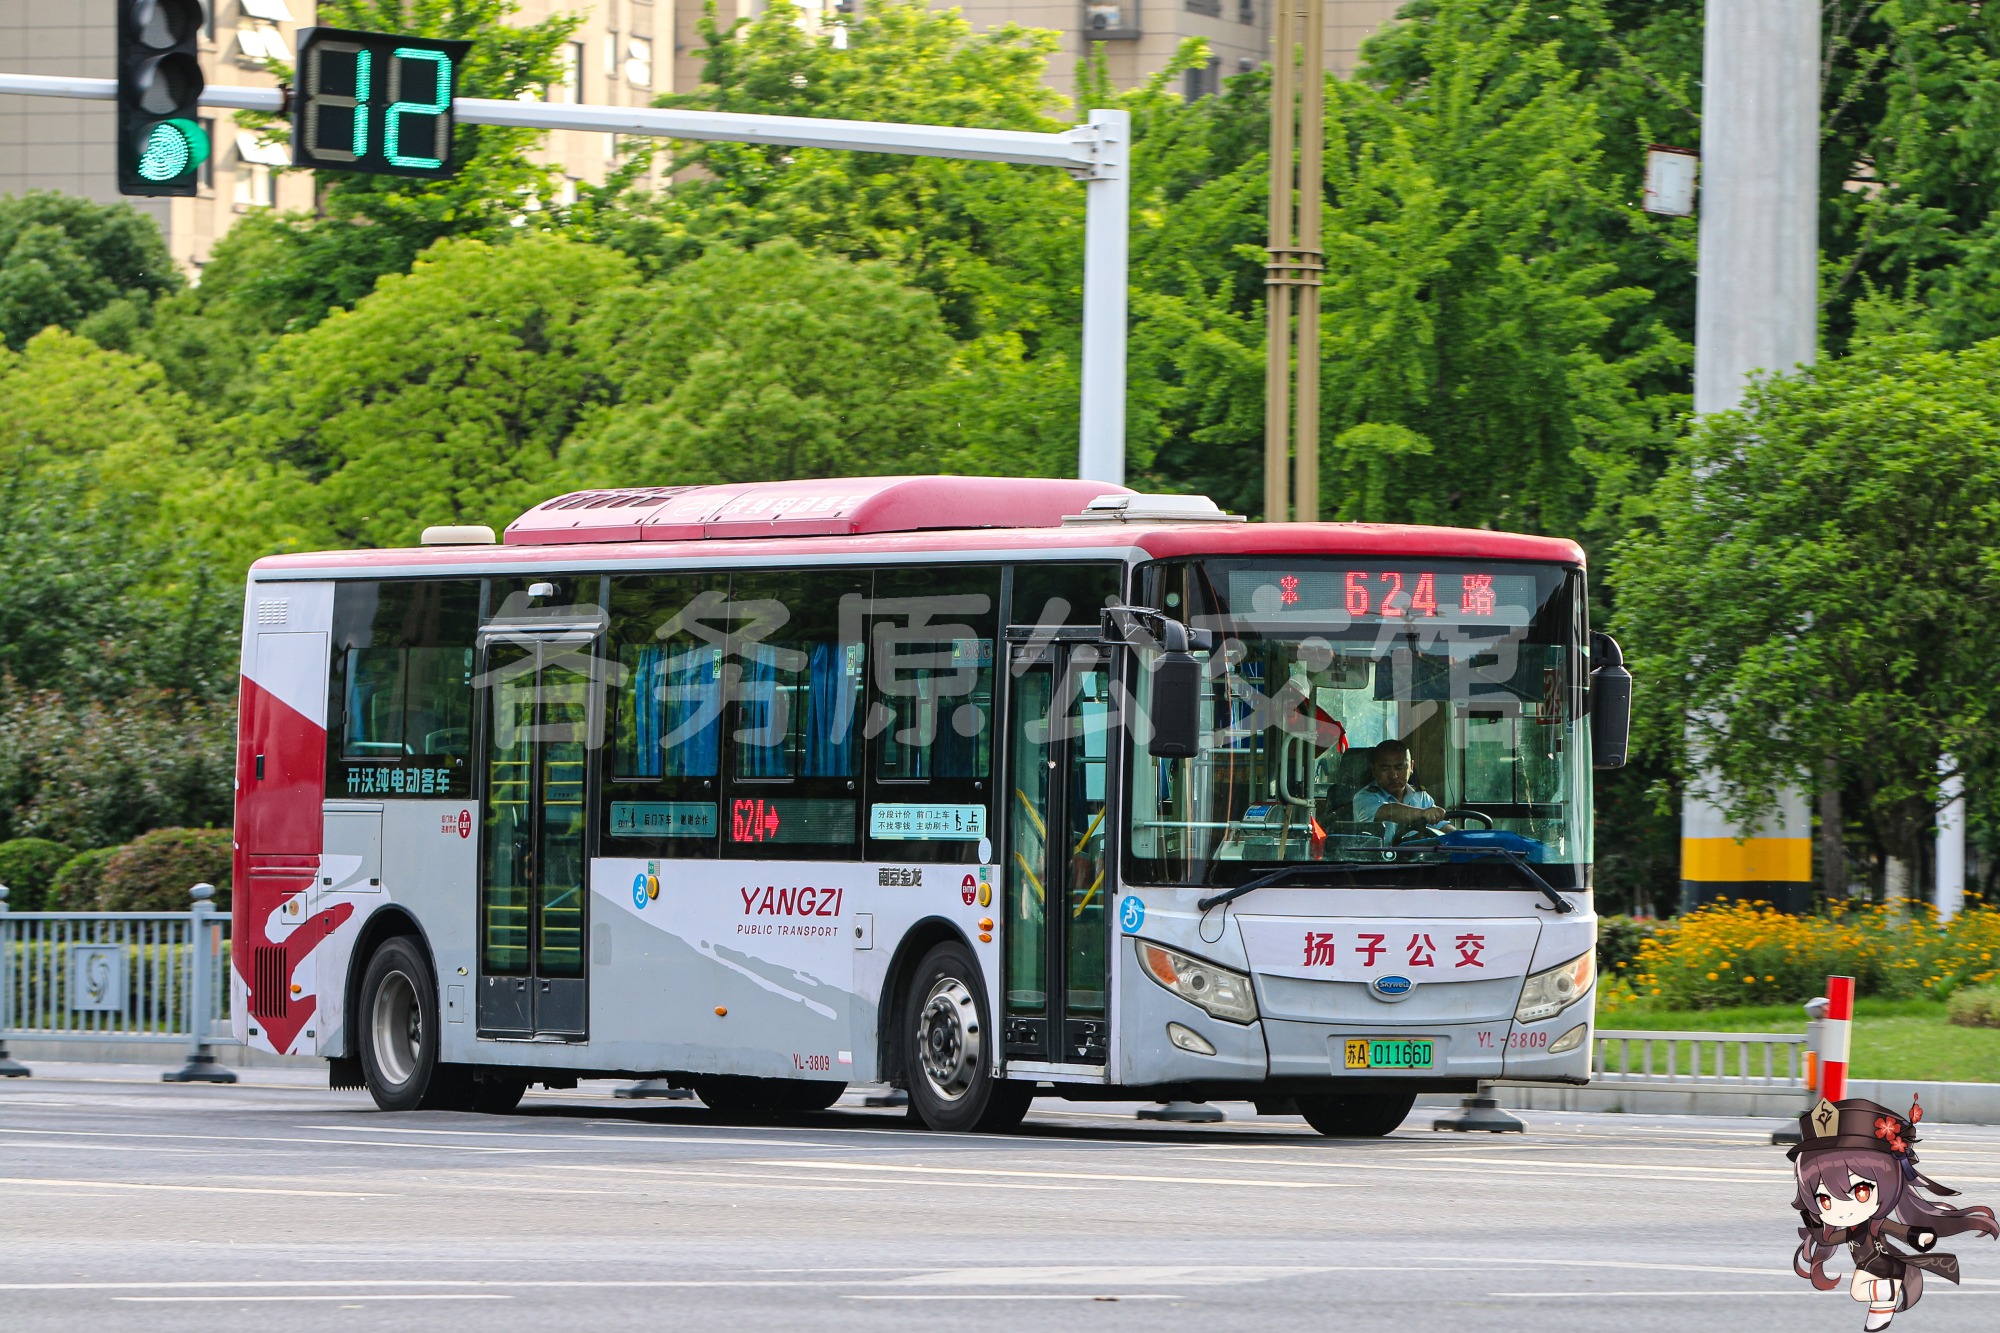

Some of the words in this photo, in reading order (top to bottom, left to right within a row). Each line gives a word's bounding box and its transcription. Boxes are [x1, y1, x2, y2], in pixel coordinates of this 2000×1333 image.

[351, 47, 453, 169] 12
[1346, 572, 1437, 617] 624
[1461, 574, 1496, 616] 路
[347, 767, 451, 794] 开沃纯电动客车
[462, 811, 468, 821] 下
[621, 807, 627, 817] 下
[878, 810, 911, 820] 分段计价
[916, 810, 950, 820] 前门上车
[967, 811, 978, 824] 上
[459, 821, 470, 829] EXIT
[644, 813, 672, 827] 后门下车
[680, 814, 708, 827] 谢谢合作
[733, 799, 764, 842] 624
[878, 821, 911, 831] 不找零钱
[916, 821, 950, 831] 主动刷卡
[966, 825, 980, 833] ENTRY
[878, 867, 922, 887] 南京金龙
[962, 885, 975, 894] ENTRY
[741, 886, 843, 917] YANGZI
[966, 893, 972, 903] 上
[737, 924, 773, 935] PUBLIC
[777, 925, 838, 937] TRANSPORT
[1303, 931, 1485, 968] 扬子公交
[1373, 1044, 1432, 1065] 01166D
[793, 1053, 830, 1071] YL-3809
